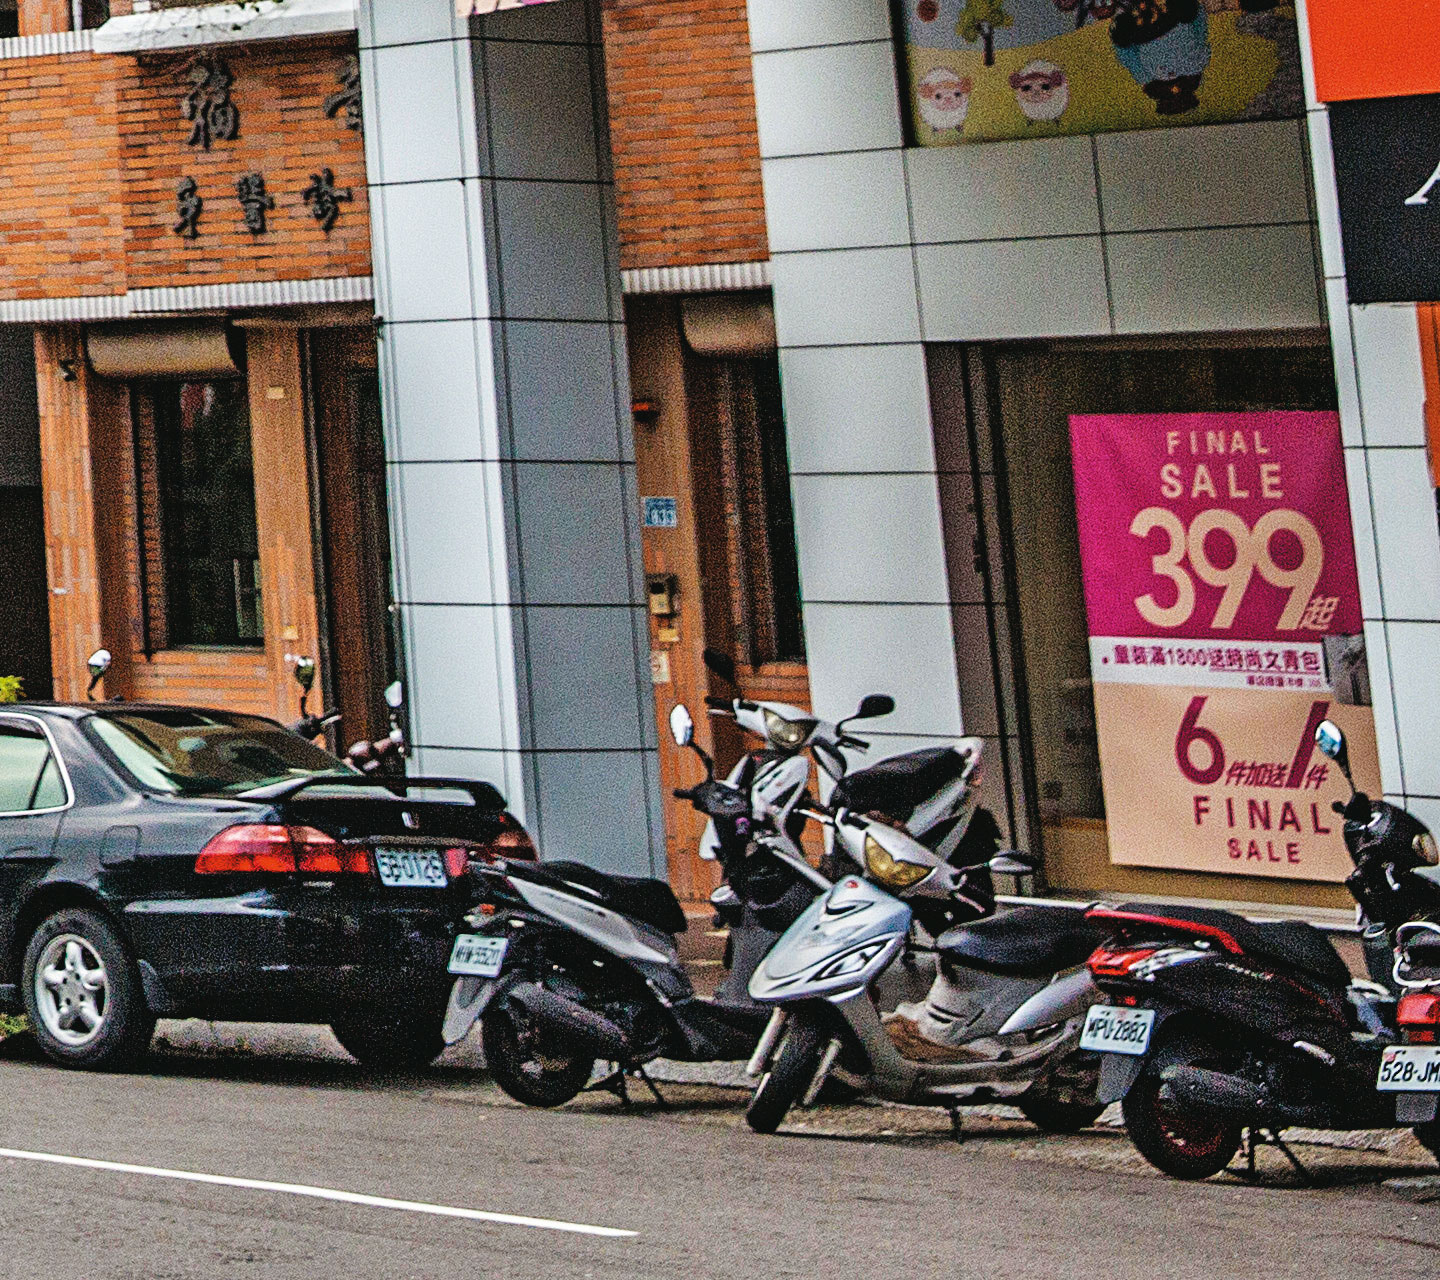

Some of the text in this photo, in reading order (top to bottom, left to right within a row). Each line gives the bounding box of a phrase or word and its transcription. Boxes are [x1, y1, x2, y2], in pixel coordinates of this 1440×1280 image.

[1166, 429, 1271, 455] FINAL
[1159, 462, 1284, 499] SALE
[1192, 795, 1332, 835] FINAL
[1226, 837, 1303, 865] SALE
[1381, 1061, 1440, 1083] 528-JM
